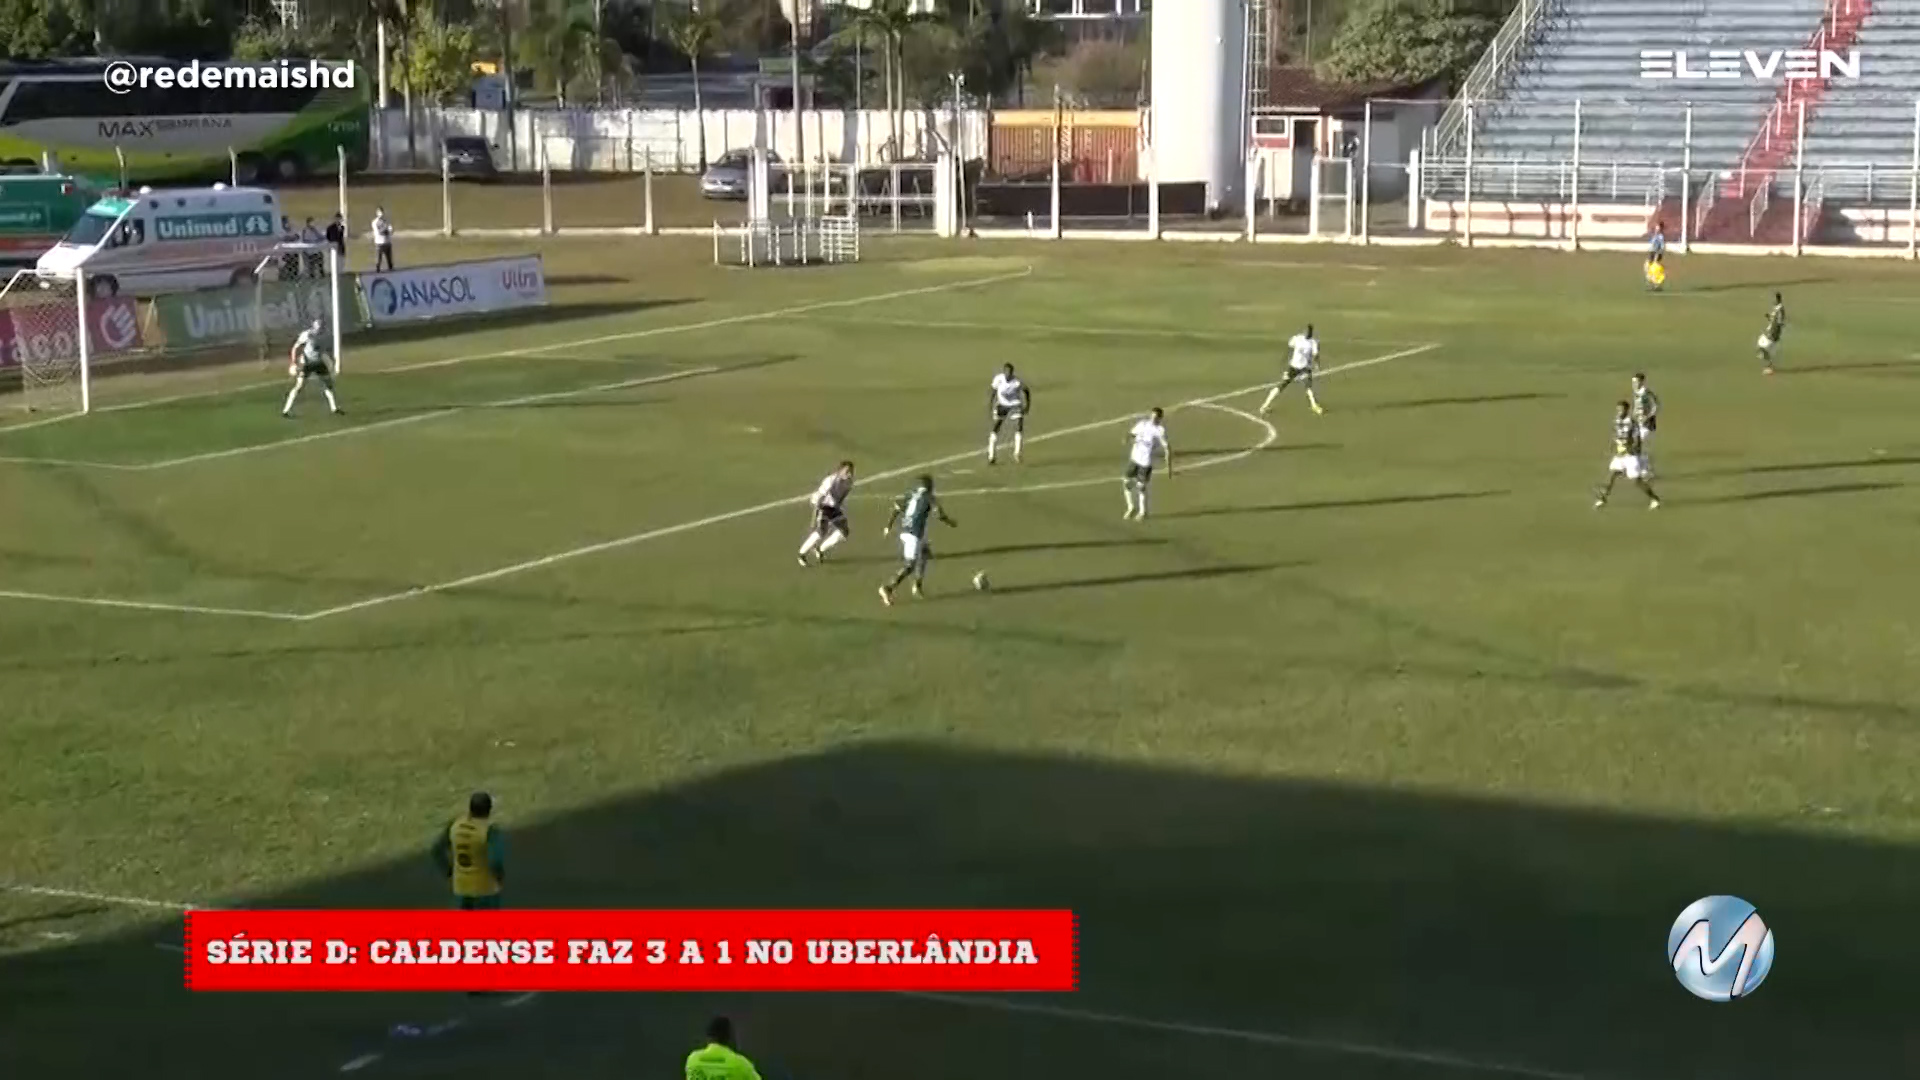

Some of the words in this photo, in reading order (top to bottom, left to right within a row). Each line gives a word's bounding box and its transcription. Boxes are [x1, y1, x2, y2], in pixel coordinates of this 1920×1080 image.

[98, 120, 154, 138] MAX
[159, 217, 238, 238] Unimed
[400, 276, 476, 308] ANASOL
